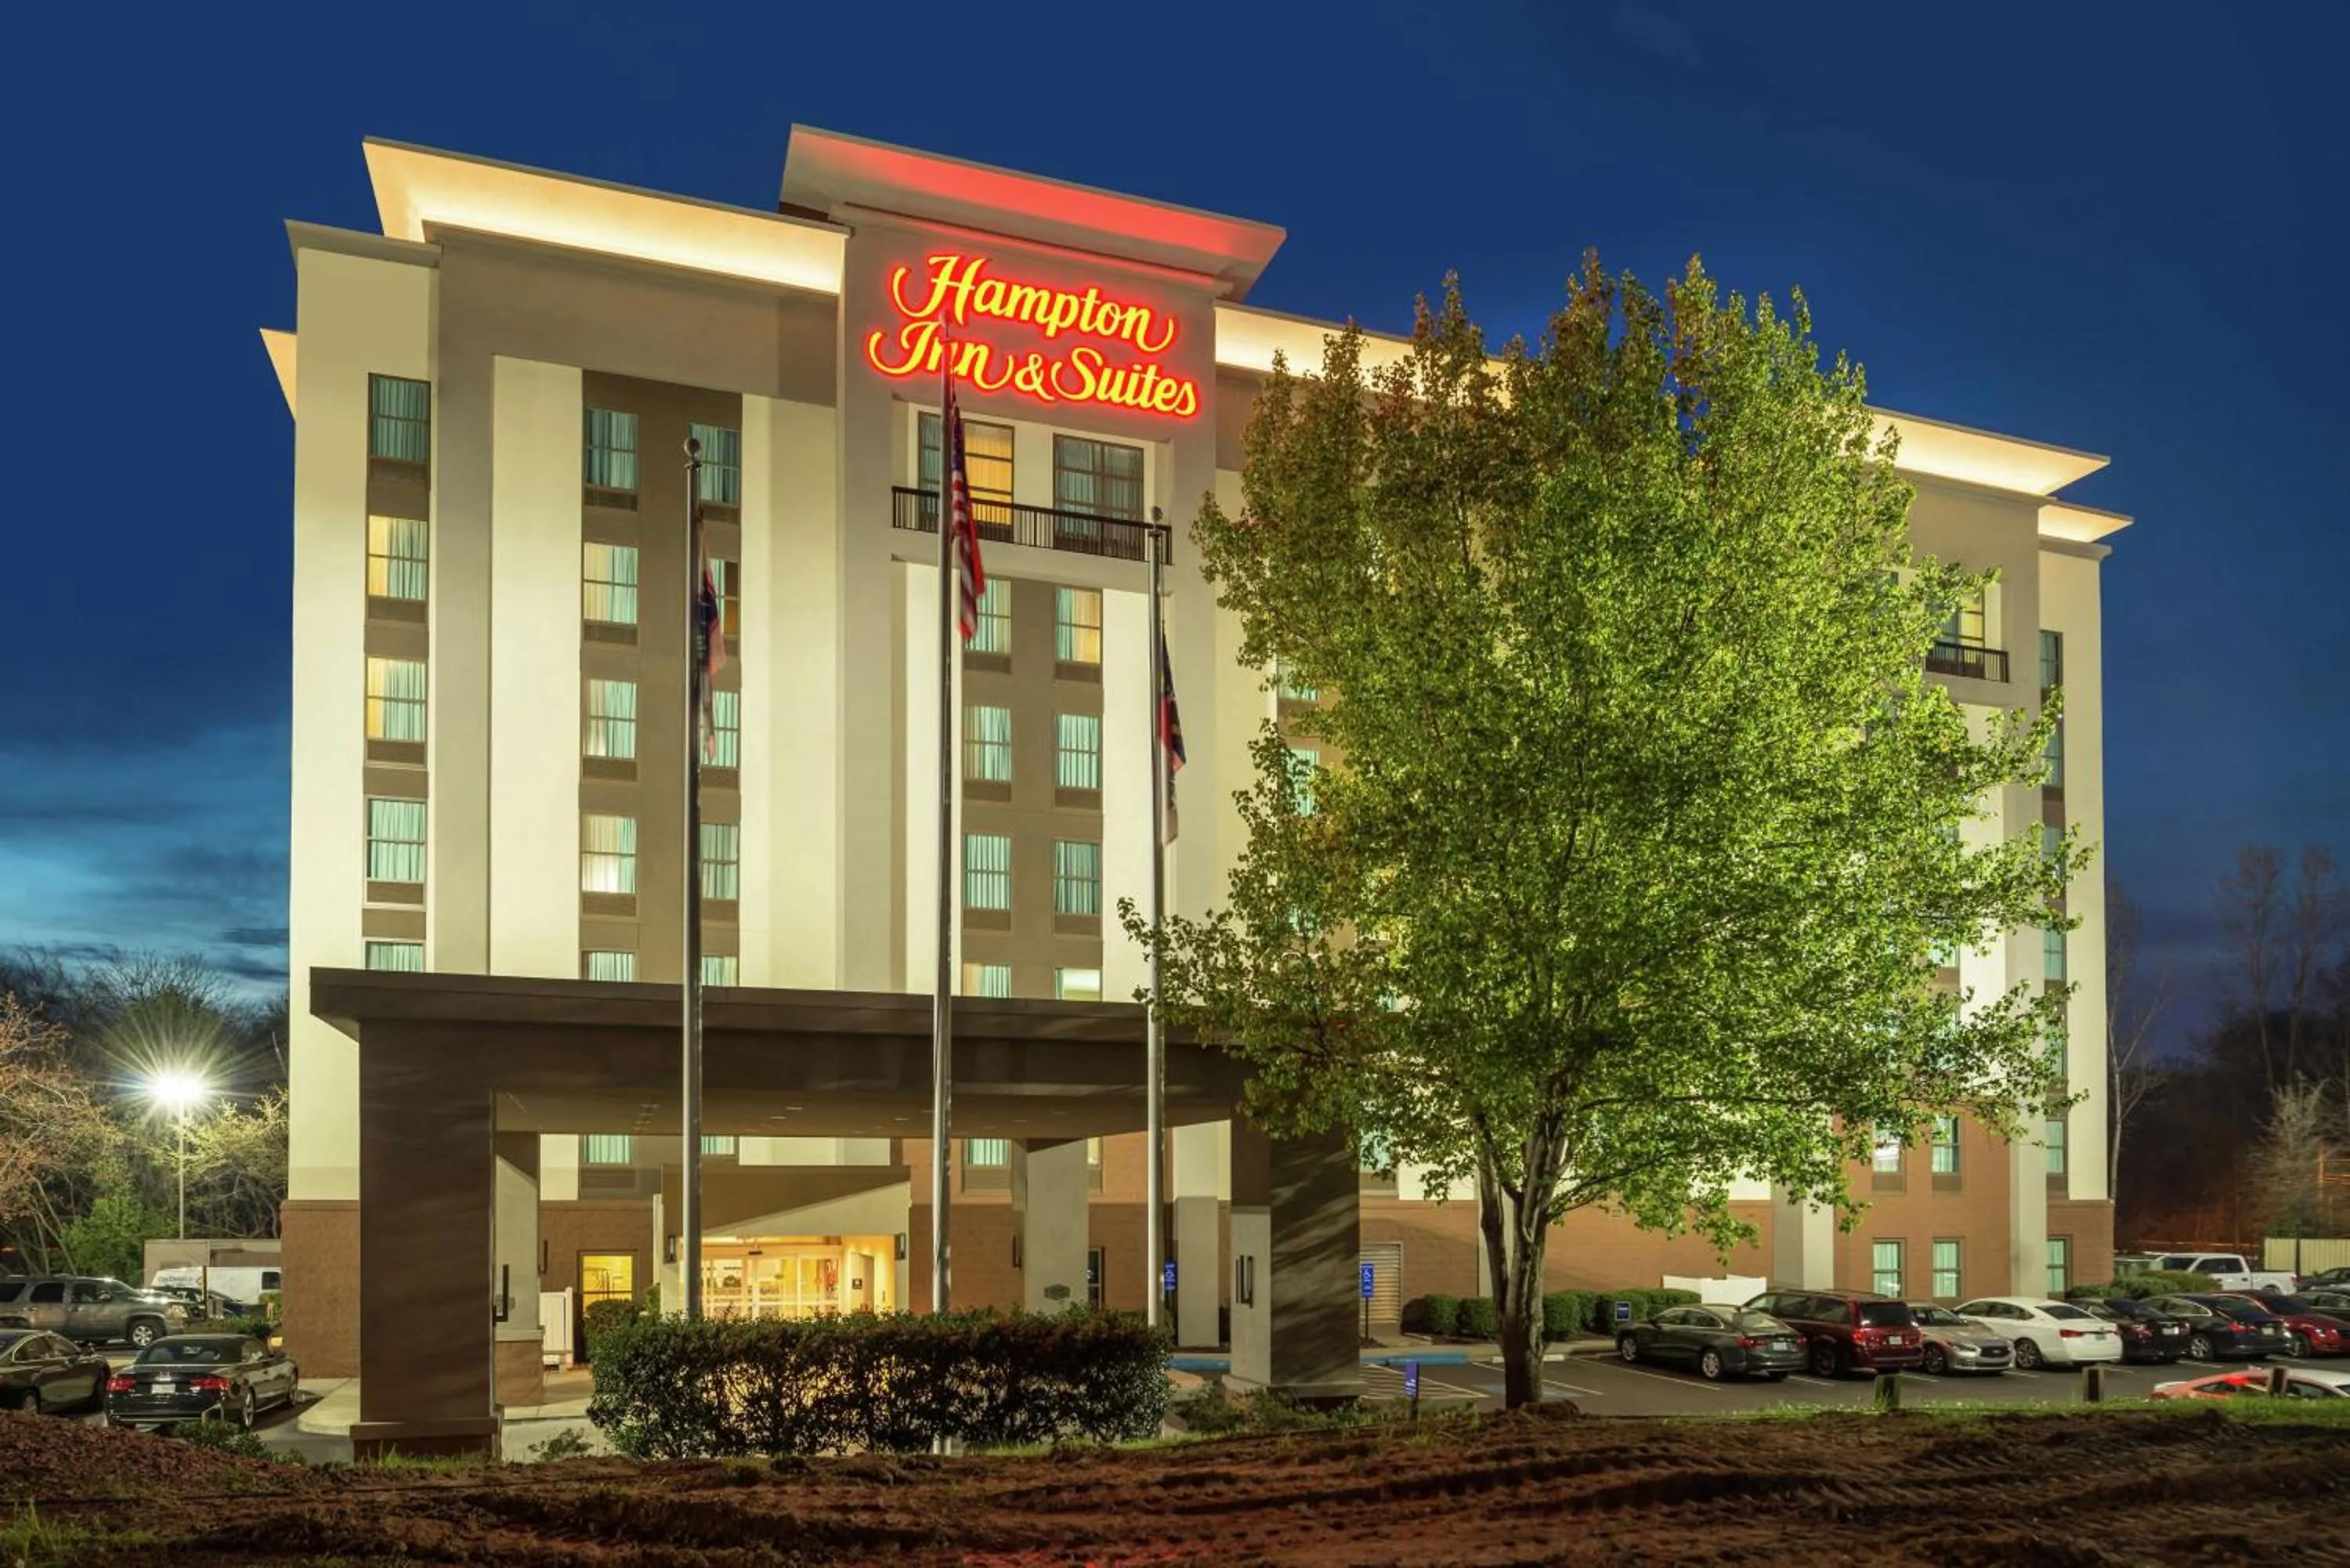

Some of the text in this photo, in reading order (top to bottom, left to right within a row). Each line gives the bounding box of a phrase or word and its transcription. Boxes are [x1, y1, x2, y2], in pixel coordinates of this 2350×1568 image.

[892, 256, 1174, 352] Hampton
[1014, 353, 1054, 400] &
[1050, 347, 1197, 416] Suites
